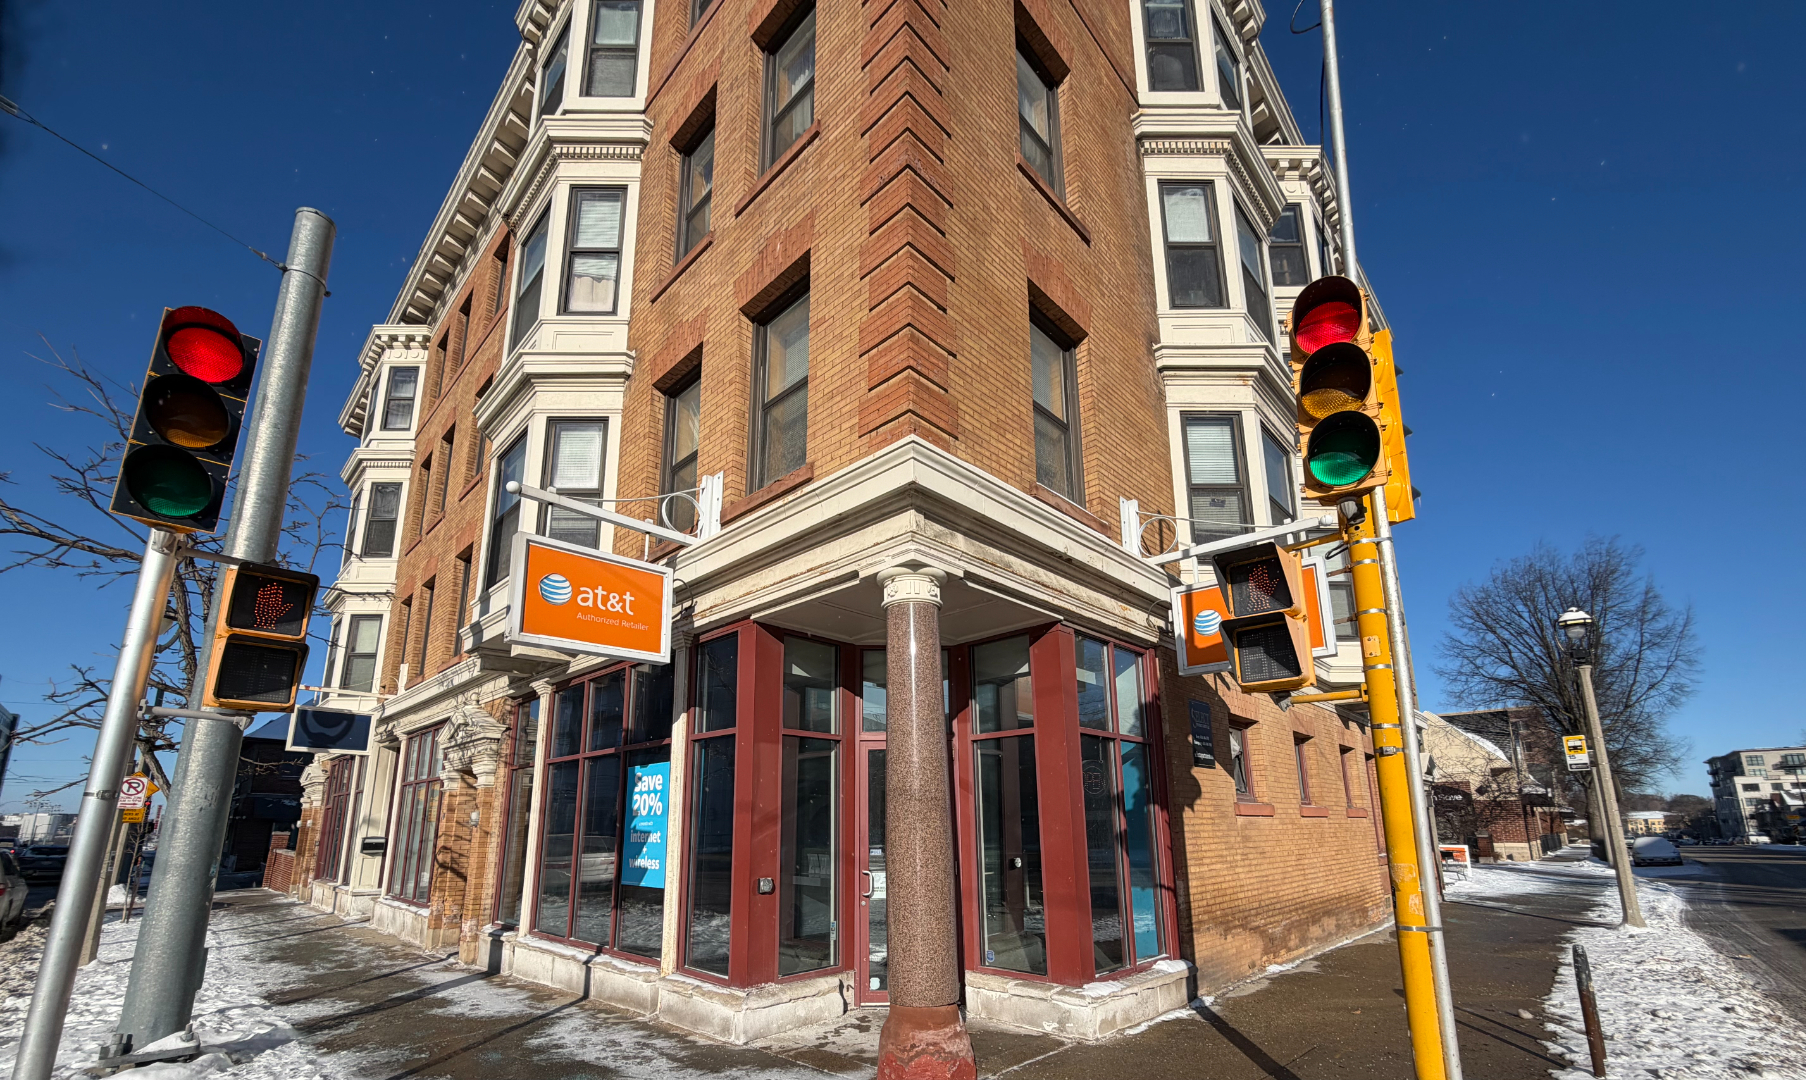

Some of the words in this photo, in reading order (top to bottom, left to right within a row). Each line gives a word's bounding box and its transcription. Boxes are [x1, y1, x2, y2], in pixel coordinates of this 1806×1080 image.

[577, 585, 635, 615] at&t
[576, 612, 620, 626] Authorized
[621, 620, 649, 631] Retailer
[634, 772, 663, 792] Save
[632, 793, 663, 816] 20%
[630, 830, 661, 843] internet
[629, 855, 660, 870] wireless
